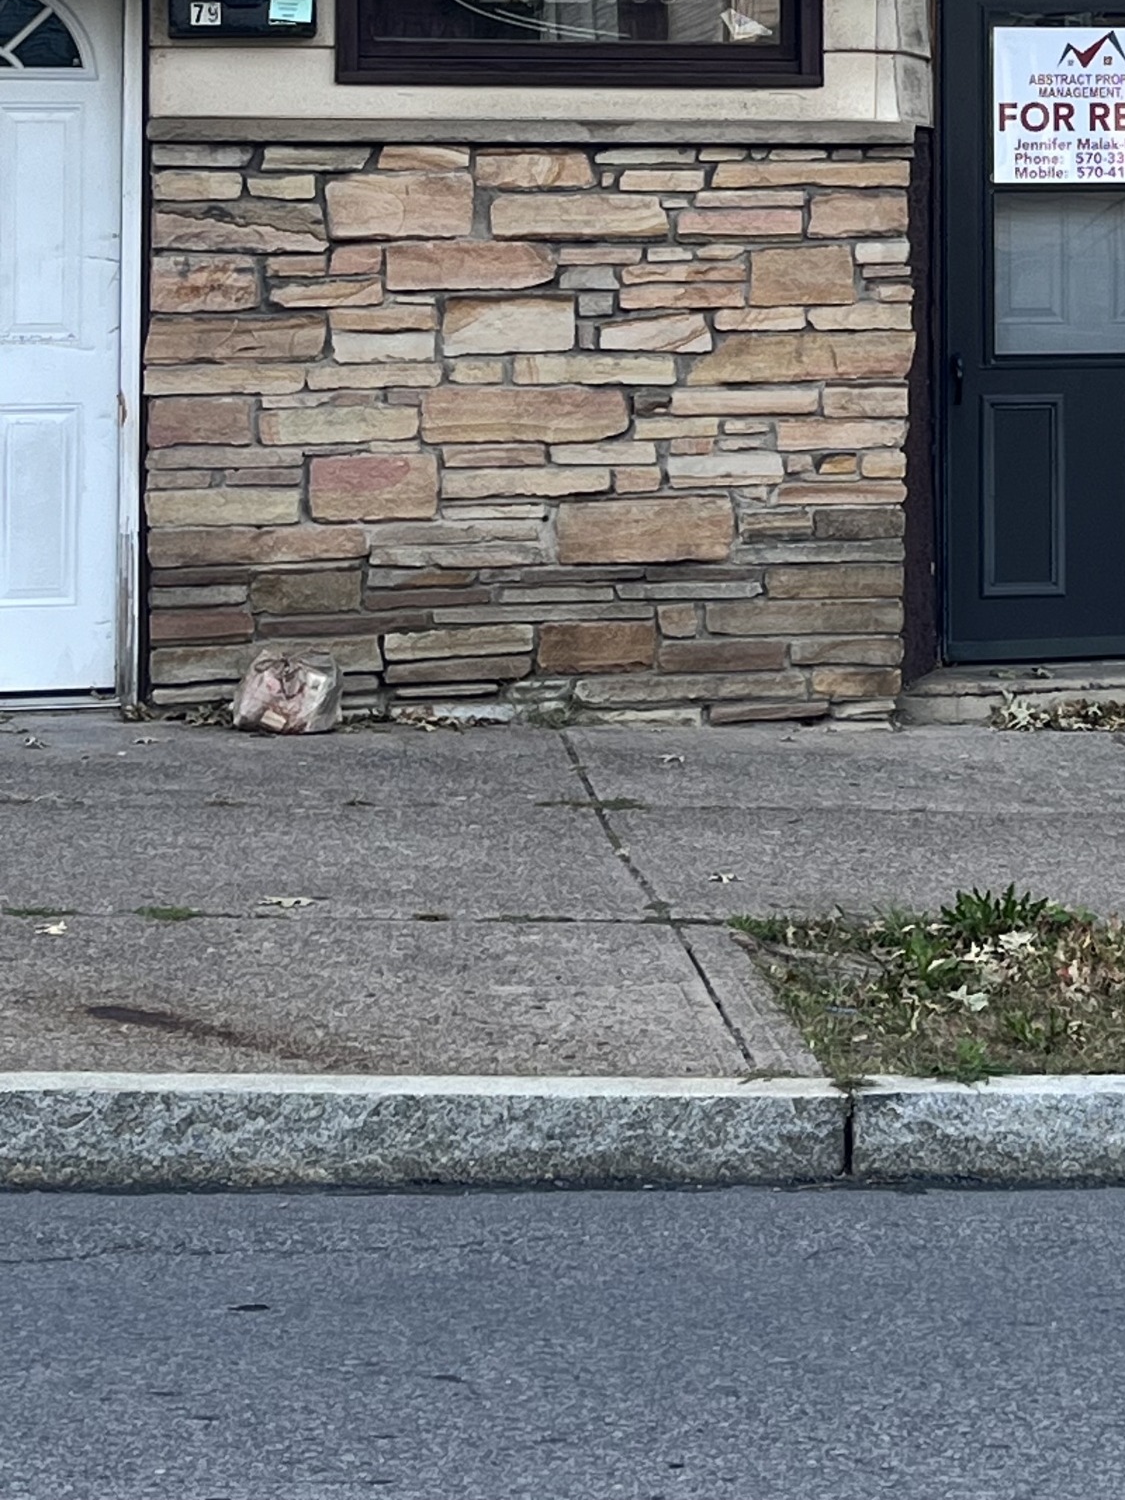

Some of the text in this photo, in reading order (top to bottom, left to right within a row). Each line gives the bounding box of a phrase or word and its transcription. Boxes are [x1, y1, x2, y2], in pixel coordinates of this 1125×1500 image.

[193, 2, 219, 23] 79
[1028, 73, 1093, 85] ABSTRACT
[1038, 87, 1124, 99] MANAGEMENT,
[998, 101, 1076, 133] FOR
[1014, 138, 1072, 151] Jennifer
[1014, 152, 1065, 165] Phone:
[1014, 166, 1069, 179] Mobile:
